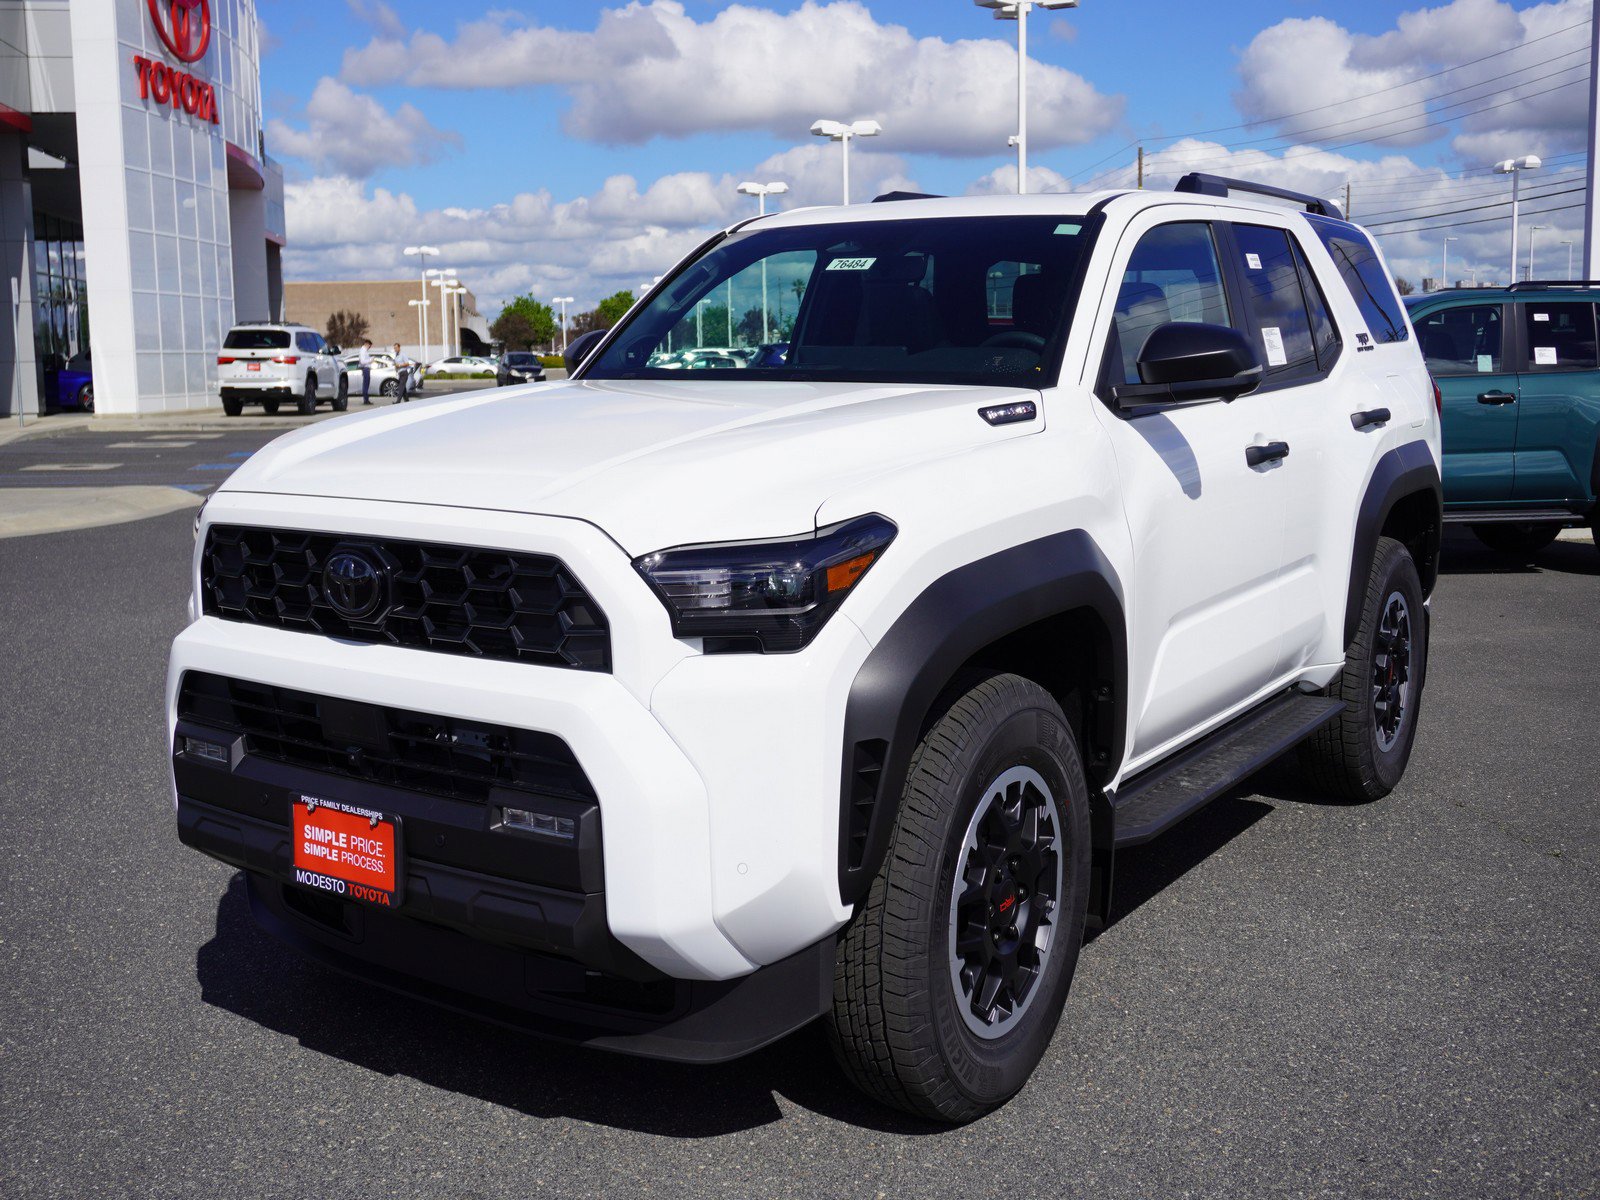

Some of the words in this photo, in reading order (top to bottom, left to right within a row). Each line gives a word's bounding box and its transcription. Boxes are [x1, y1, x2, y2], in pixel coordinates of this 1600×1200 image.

[133, 55, 220, 125] TOYOTA
[833, 259, 869, 269] 76484
[301, 795, 319, 806] PRICE
[320, 799, 341, 811] FAMILY
[341, 804, 383, 820] DEALERSHIPS
[304, 825, 347, 848] SIMPLE
[350, 835, 386, 858] PRICE.
[304, 842, 339, 861] SIMPLE
[341, 851, 386, 874] PROCESS.
[296, 869, 345, 894] MODESTO
[347, 883, 391, 906] TOYOTA
